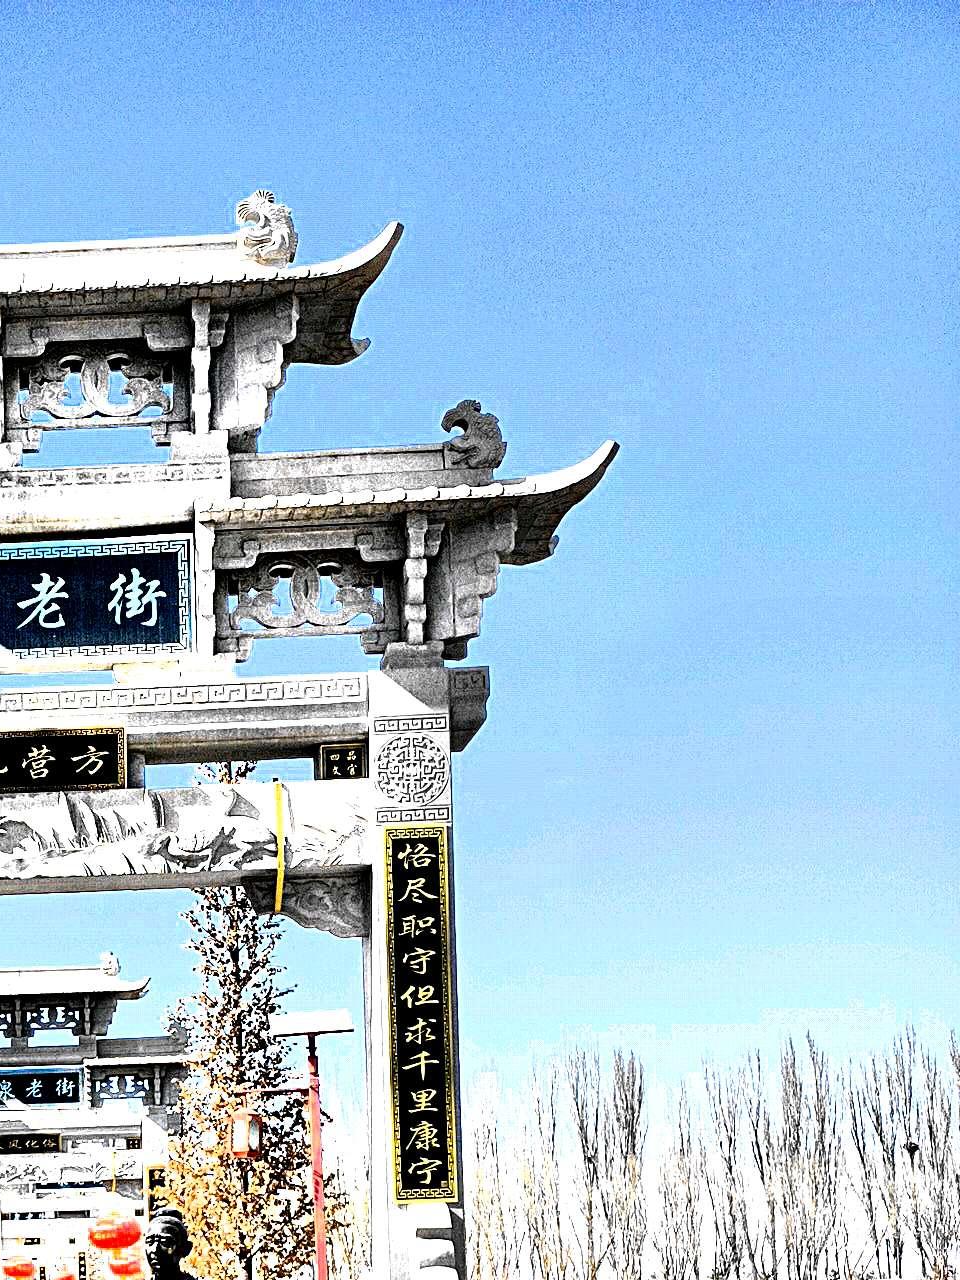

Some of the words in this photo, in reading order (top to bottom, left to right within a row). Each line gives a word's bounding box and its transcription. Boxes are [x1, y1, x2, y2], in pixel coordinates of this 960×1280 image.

[397, 842, 442, 1185] 恪尽职守但求千里康宁
